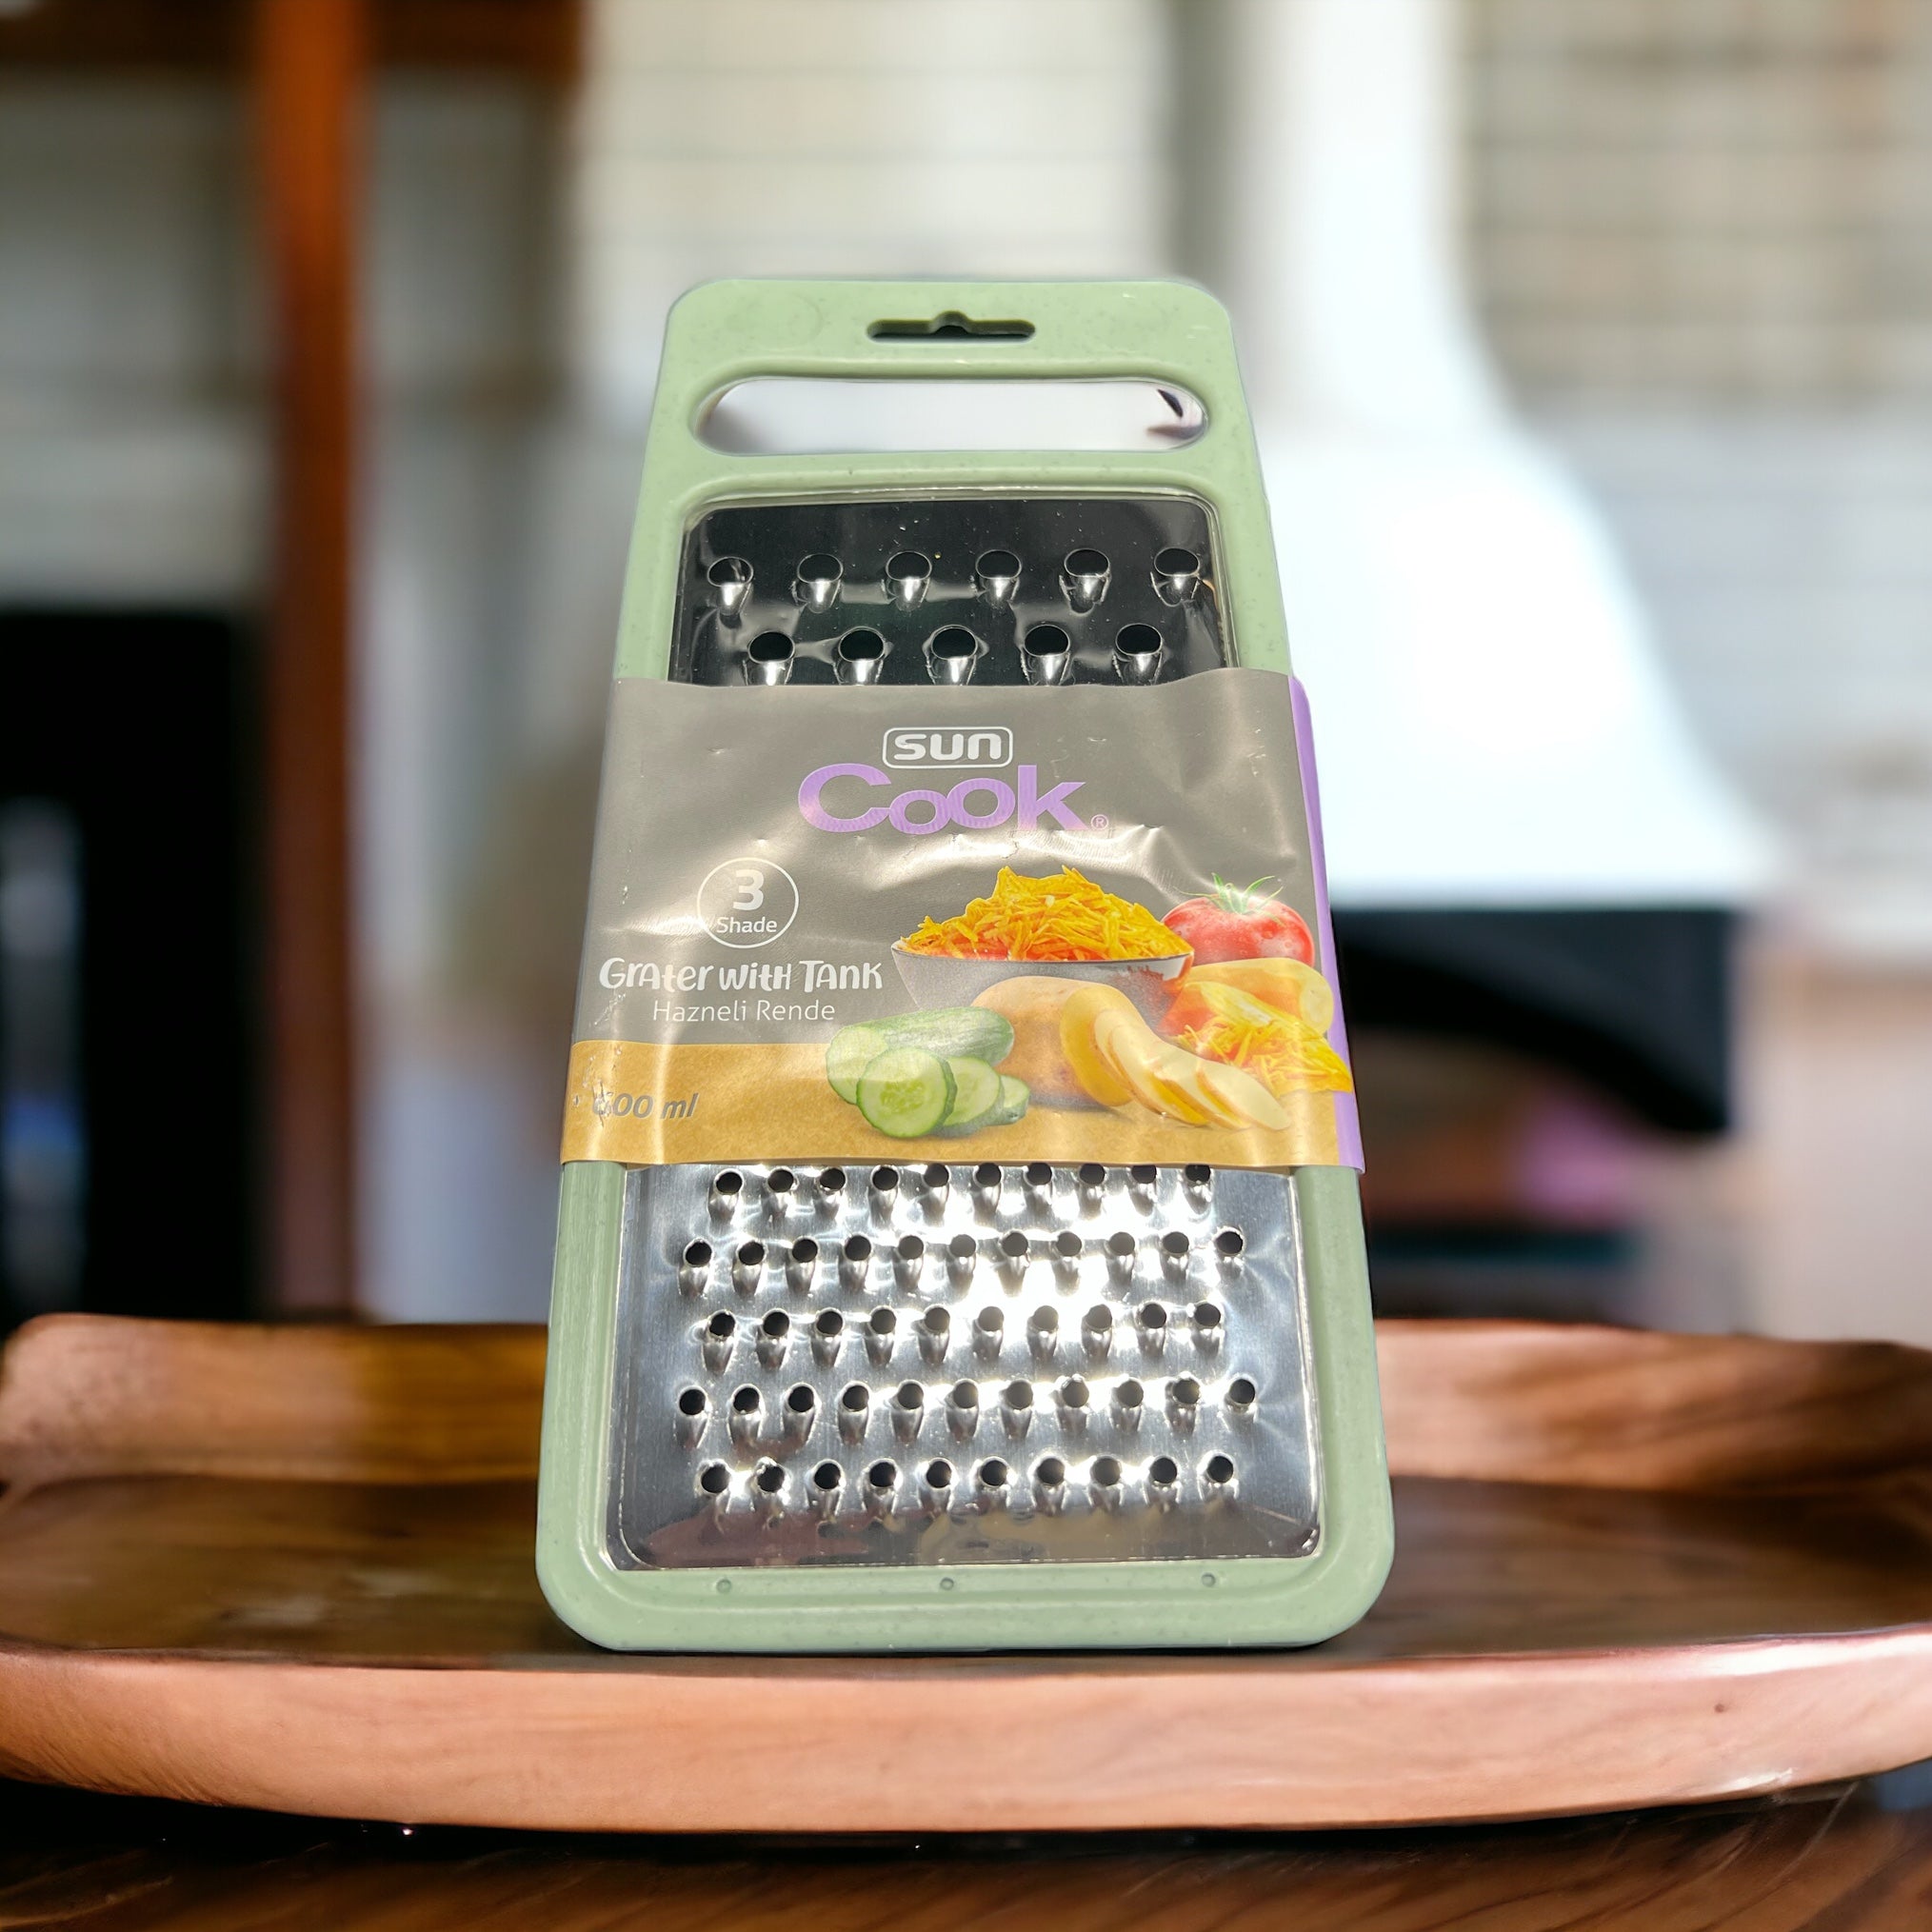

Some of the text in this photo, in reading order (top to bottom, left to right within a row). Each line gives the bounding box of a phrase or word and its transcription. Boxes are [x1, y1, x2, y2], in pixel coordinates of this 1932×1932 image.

[798, 763, 1089, 835] Cook
[732, 868, 765, 911] 3
[716, 916, 778, 933] Shade
[652, 999, 835, 1022] Hazneli Rende
[661, 1092, 699, 1119] ml
